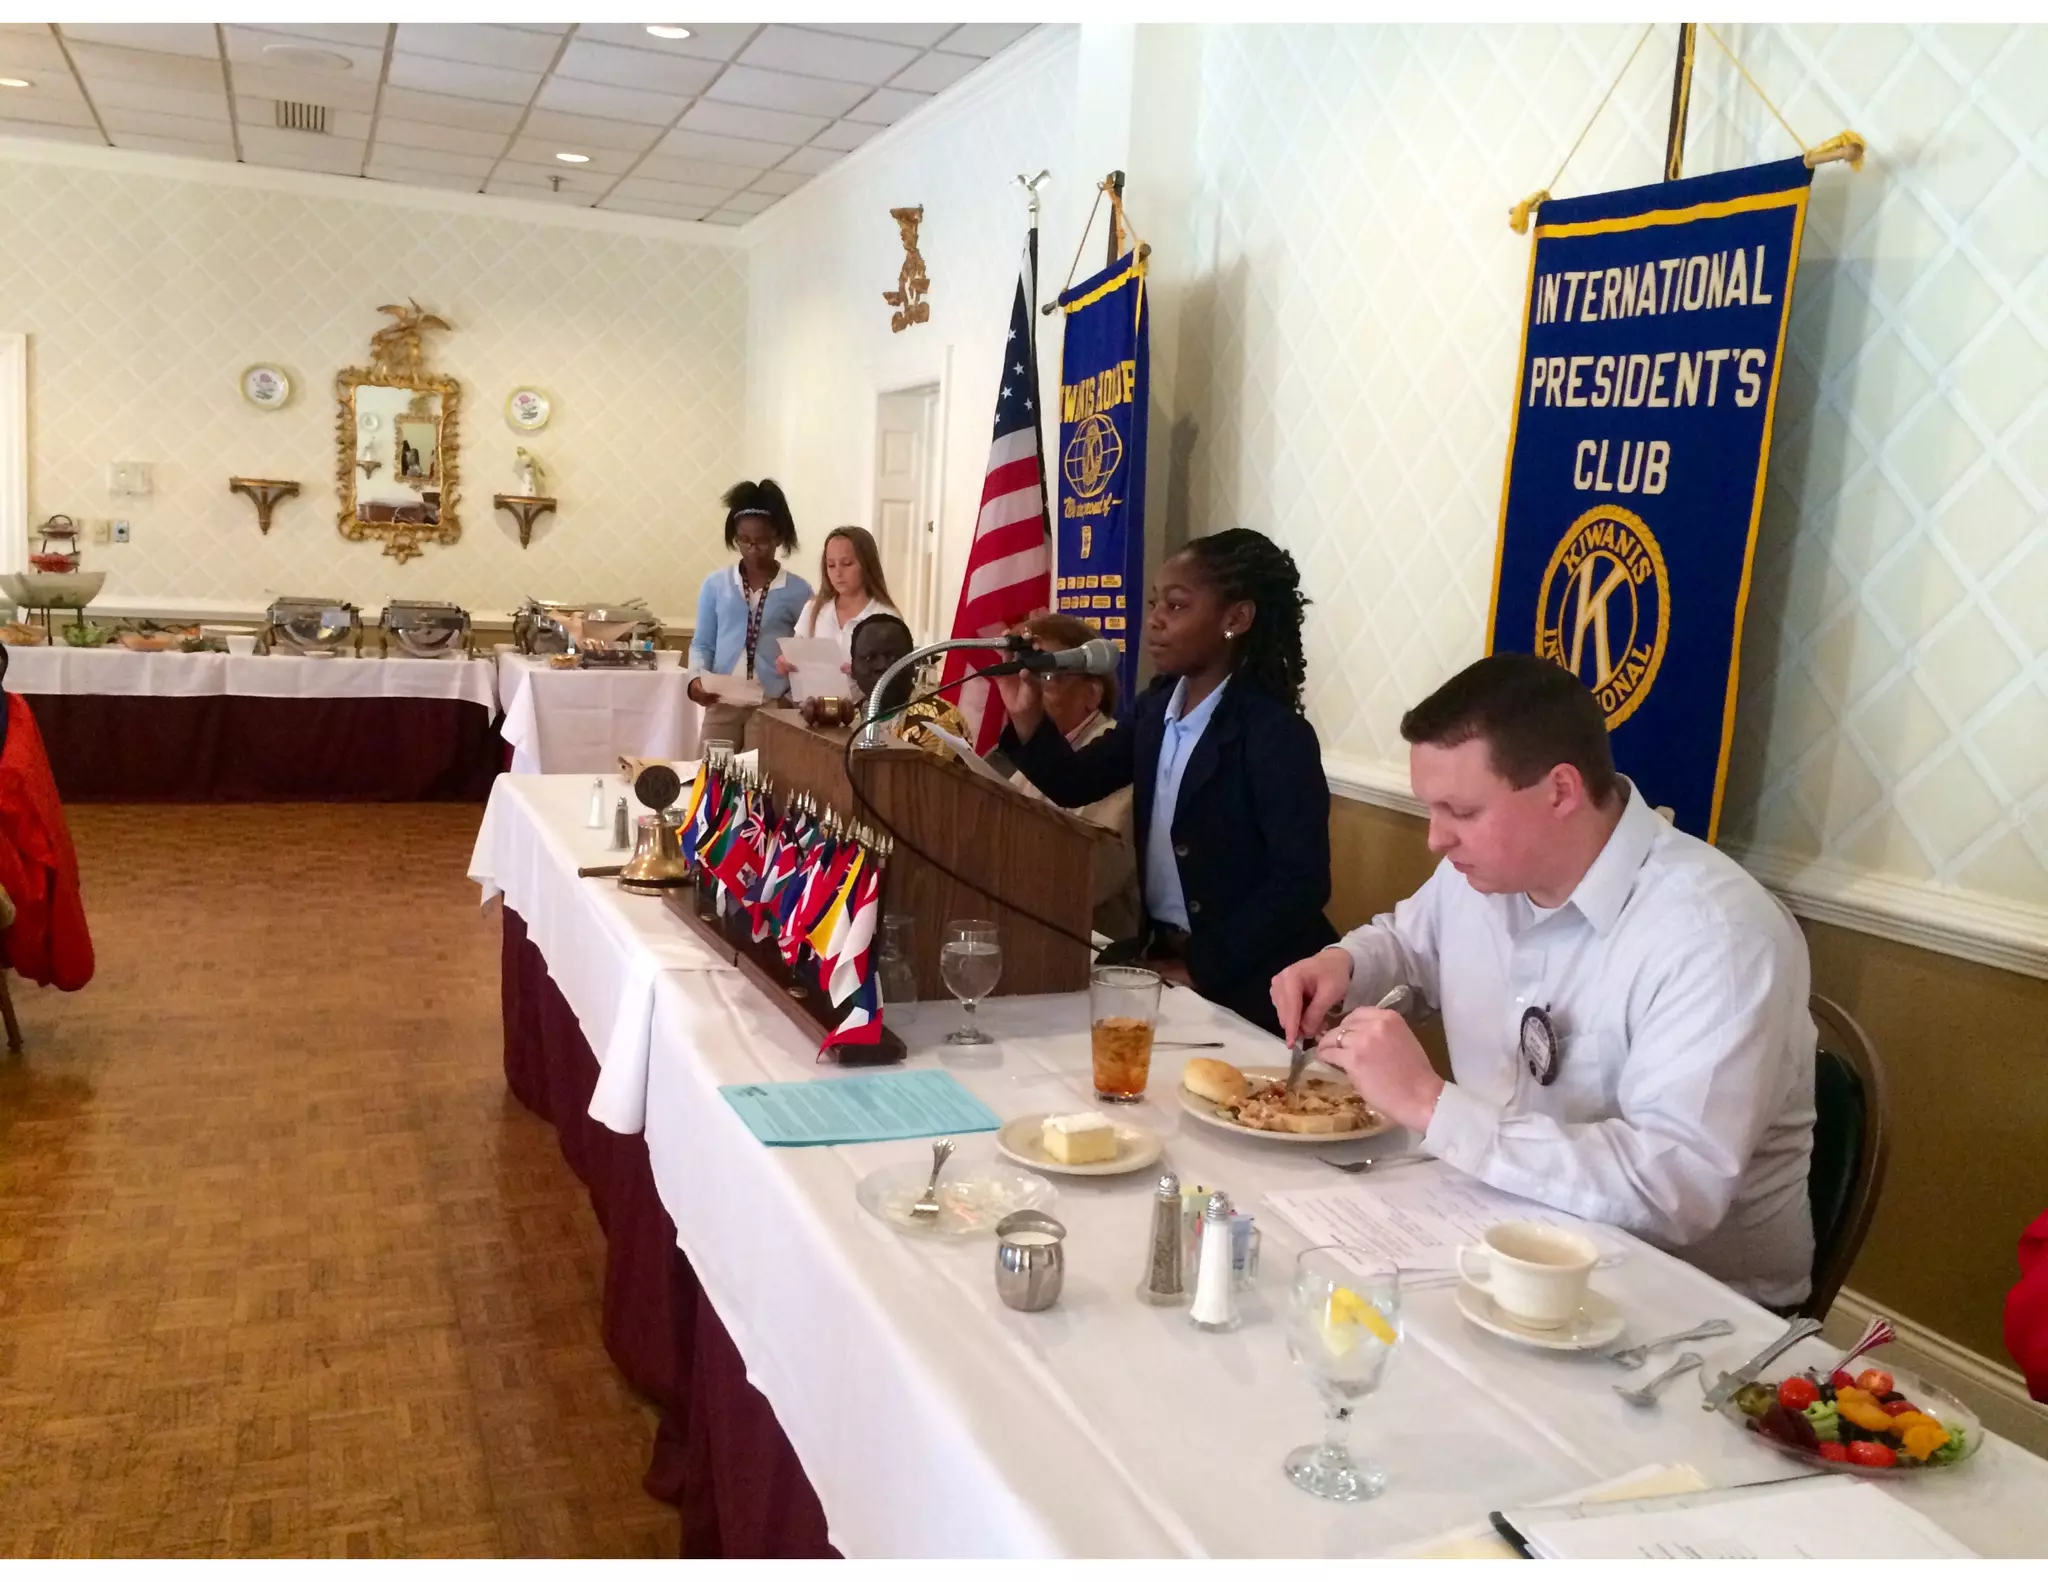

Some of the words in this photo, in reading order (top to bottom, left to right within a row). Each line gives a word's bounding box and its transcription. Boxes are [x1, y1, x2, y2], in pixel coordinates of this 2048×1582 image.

[1535, 245, 1773, 326] INTERNATIONAL
[1528, 348, 1768, 408] PRESIDENT'S
[1573, 439, 1671, 495] CLUB
[1562, 522, 1653, 585] KIWANIS
[1569, 555, 1628, 693] K
